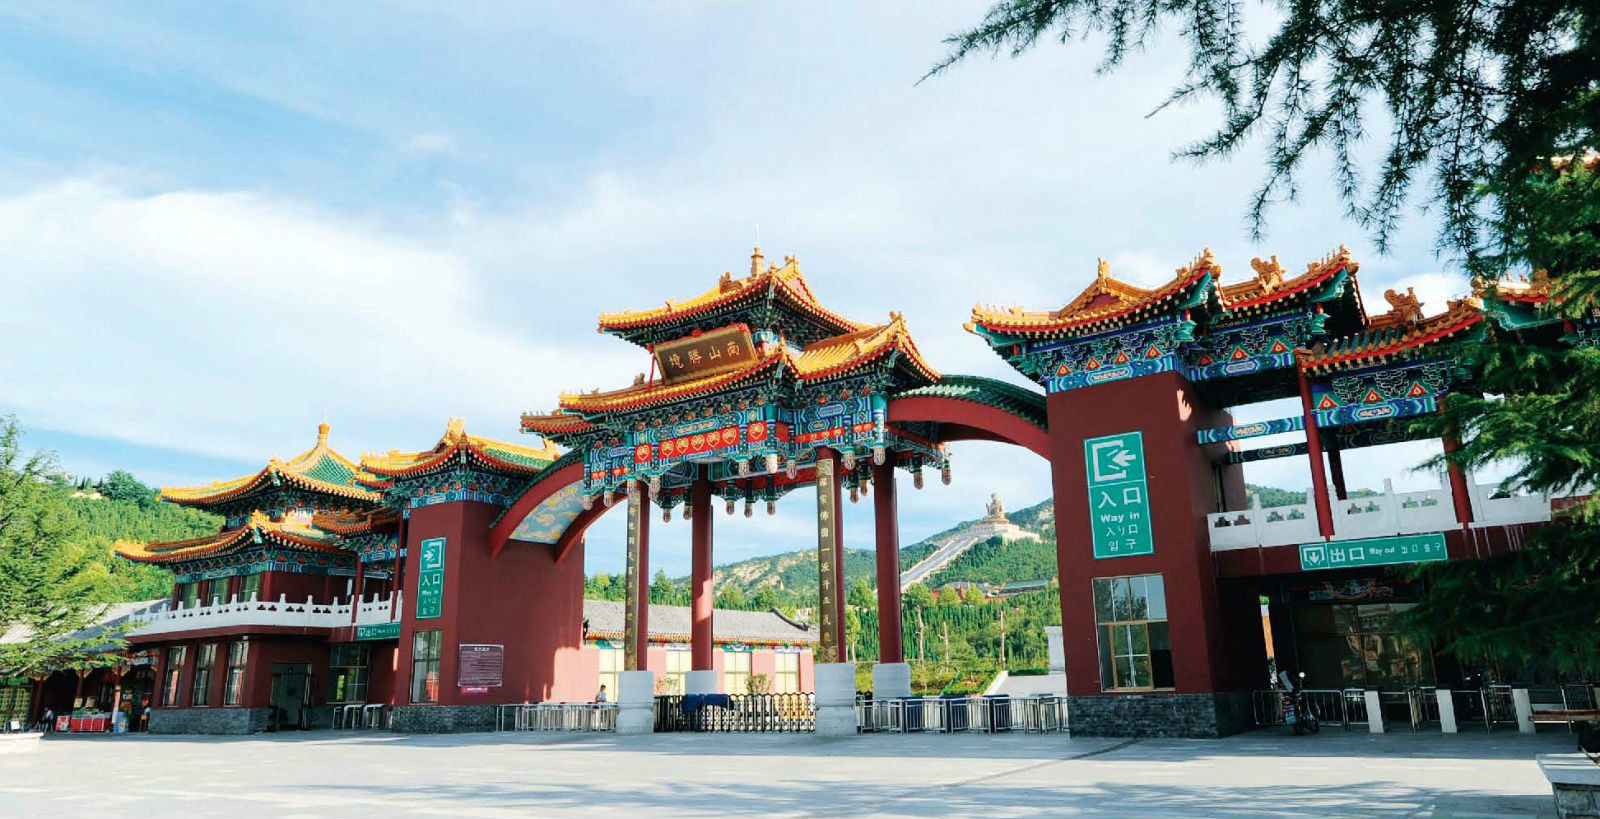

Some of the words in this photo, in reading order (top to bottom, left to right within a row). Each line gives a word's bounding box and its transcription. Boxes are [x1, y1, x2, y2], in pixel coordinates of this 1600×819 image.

[1097, 487, 1141, 509] 入口
[1100, 513, 1124, 523] Way
[1129, 511, 1140, 520] in
[1105, 524, 1138, 537] 入り口
[1108, 538, 1137, 552] 입구
[1369, 547, 1382, 556] Way
[1385, 546, 1395, 554] out
[1330, 547, 1365, 563] 出口
[421, 573, 441, 587] 入口
